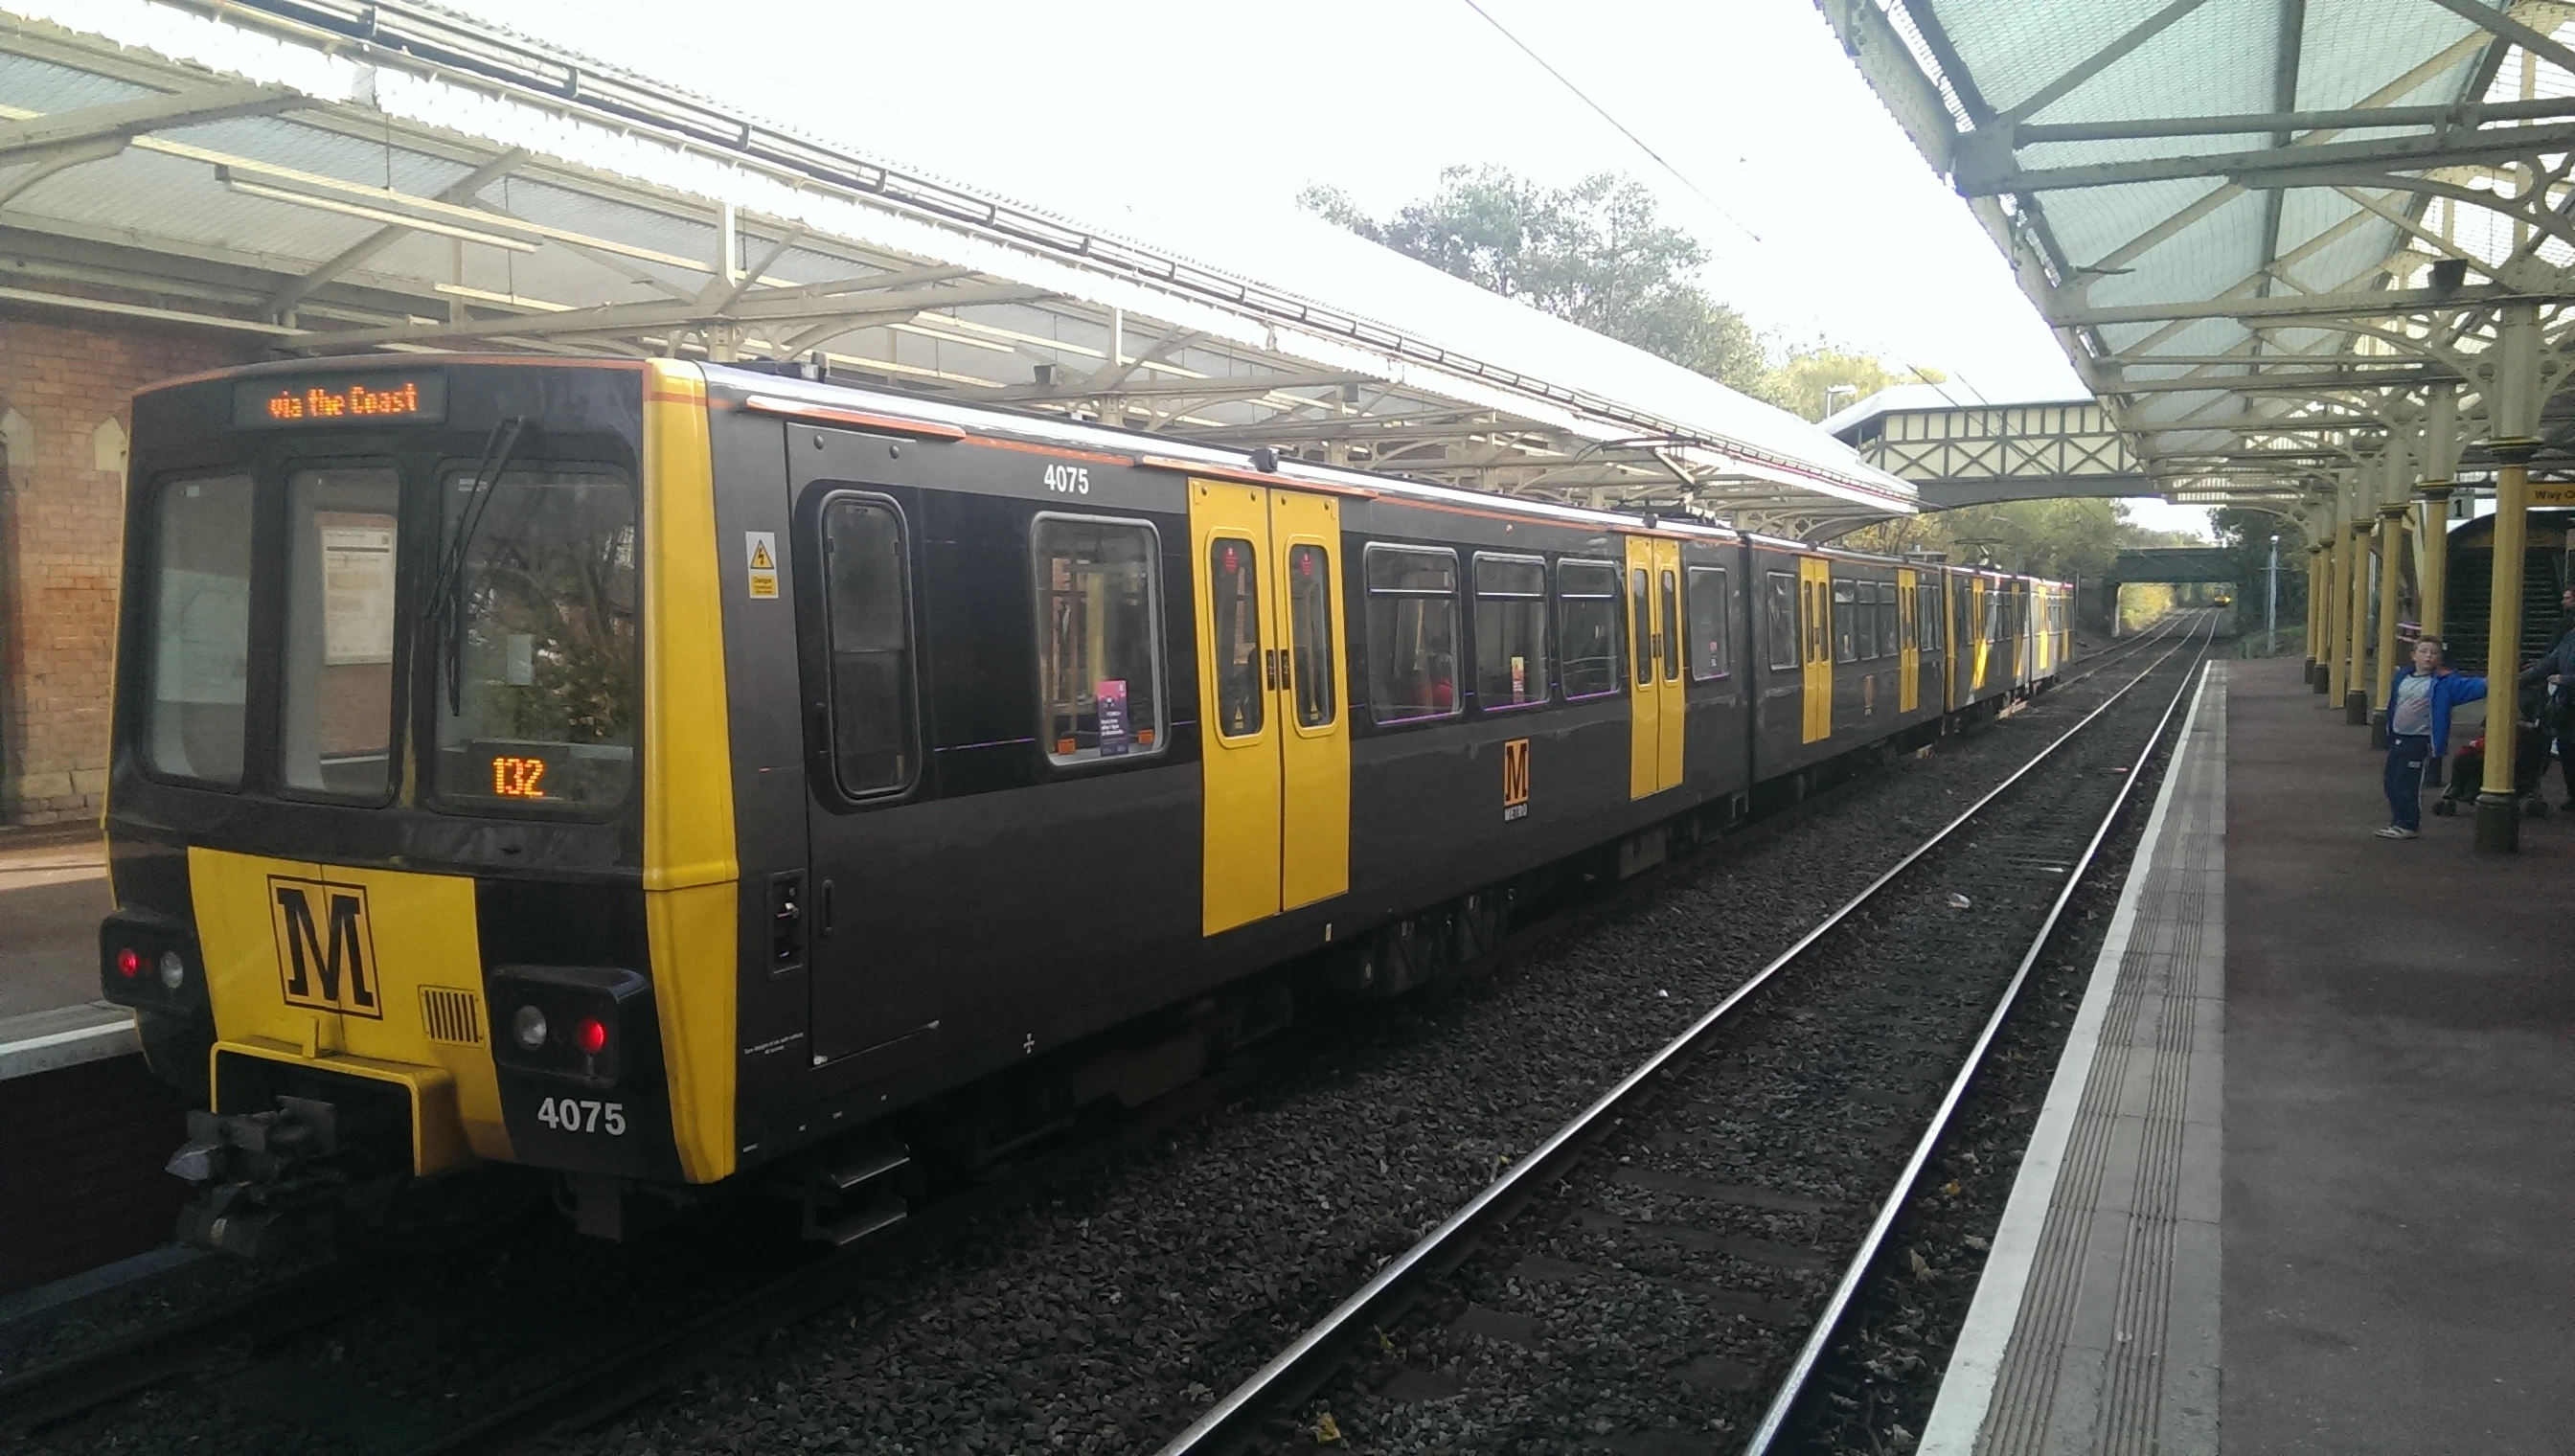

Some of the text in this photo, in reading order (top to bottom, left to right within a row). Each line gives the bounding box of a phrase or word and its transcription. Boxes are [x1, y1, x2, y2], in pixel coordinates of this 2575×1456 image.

[269, 383, 417, 419] via the Coast
[1043, 464, 1089, 494] 4075
[2534, 490, 2562, 502] Way
[2453, 499, 2463, 517] 1
[492, 758, 543, 796] 132
[1506, 743, 1527, 802] M
[1504, 804, 1528, 821] METRO
[276, 887, 375, 1008] M
[537, 1097, 627, 1136] 4075
